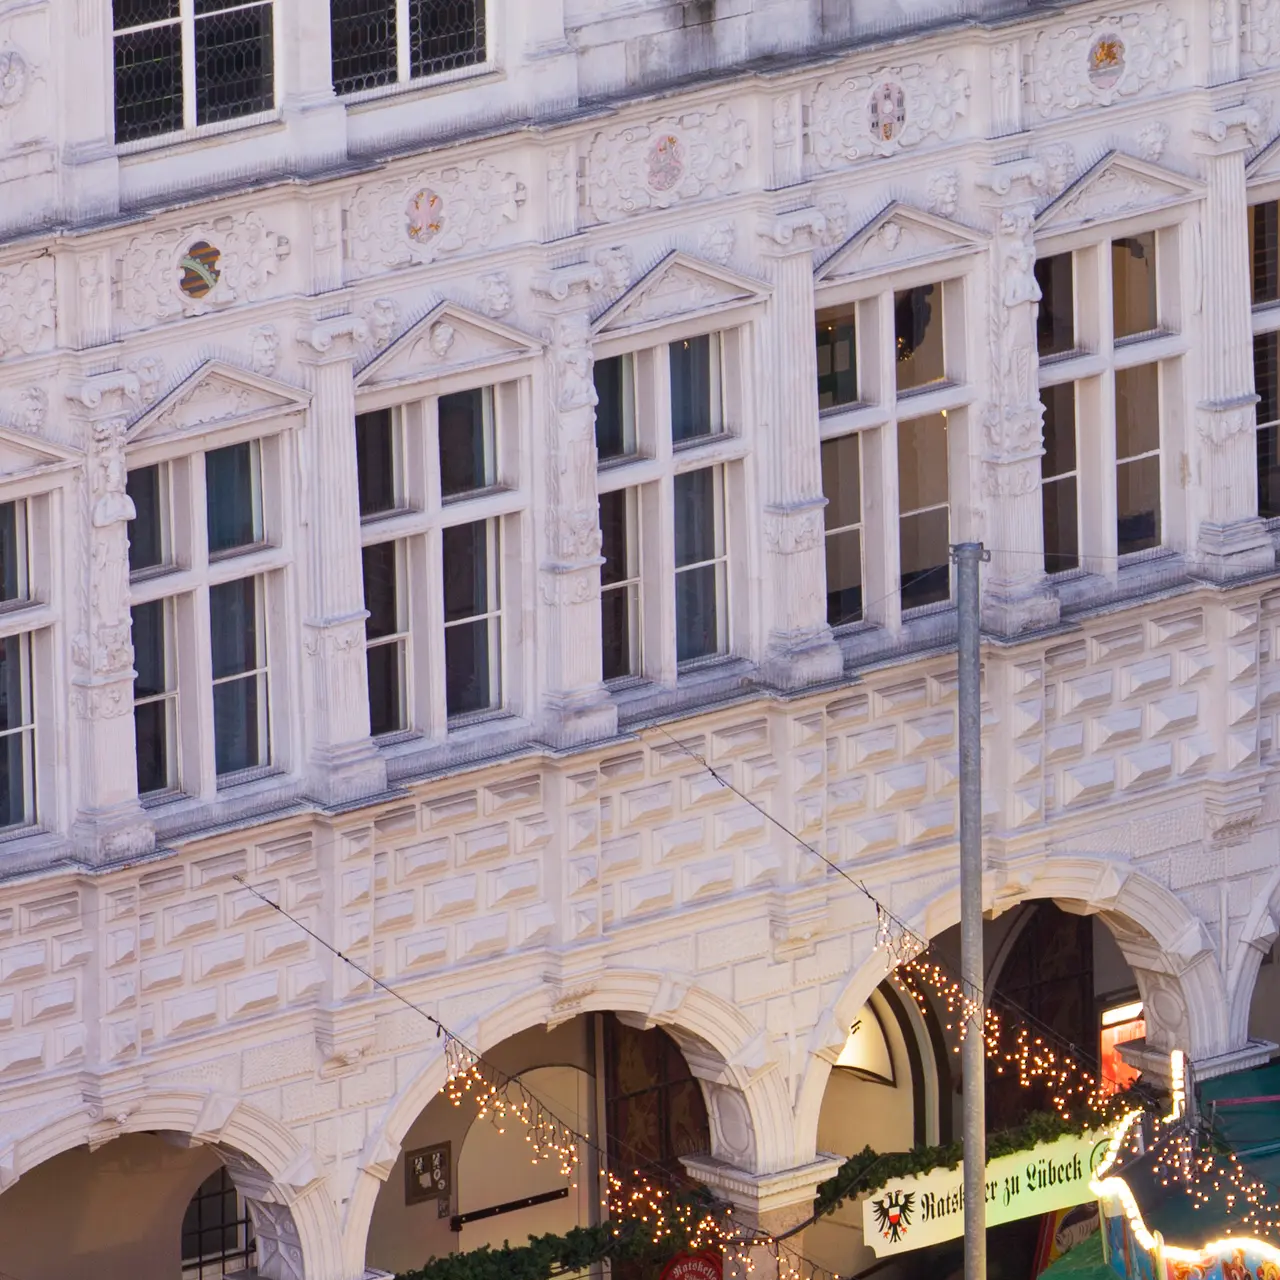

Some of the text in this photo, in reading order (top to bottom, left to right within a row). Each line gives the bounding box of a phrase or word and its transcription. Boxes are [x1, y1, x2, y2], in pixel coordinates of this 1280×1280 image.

[921, 1152, 1083, 1223] Ratsker zu Lübeck
